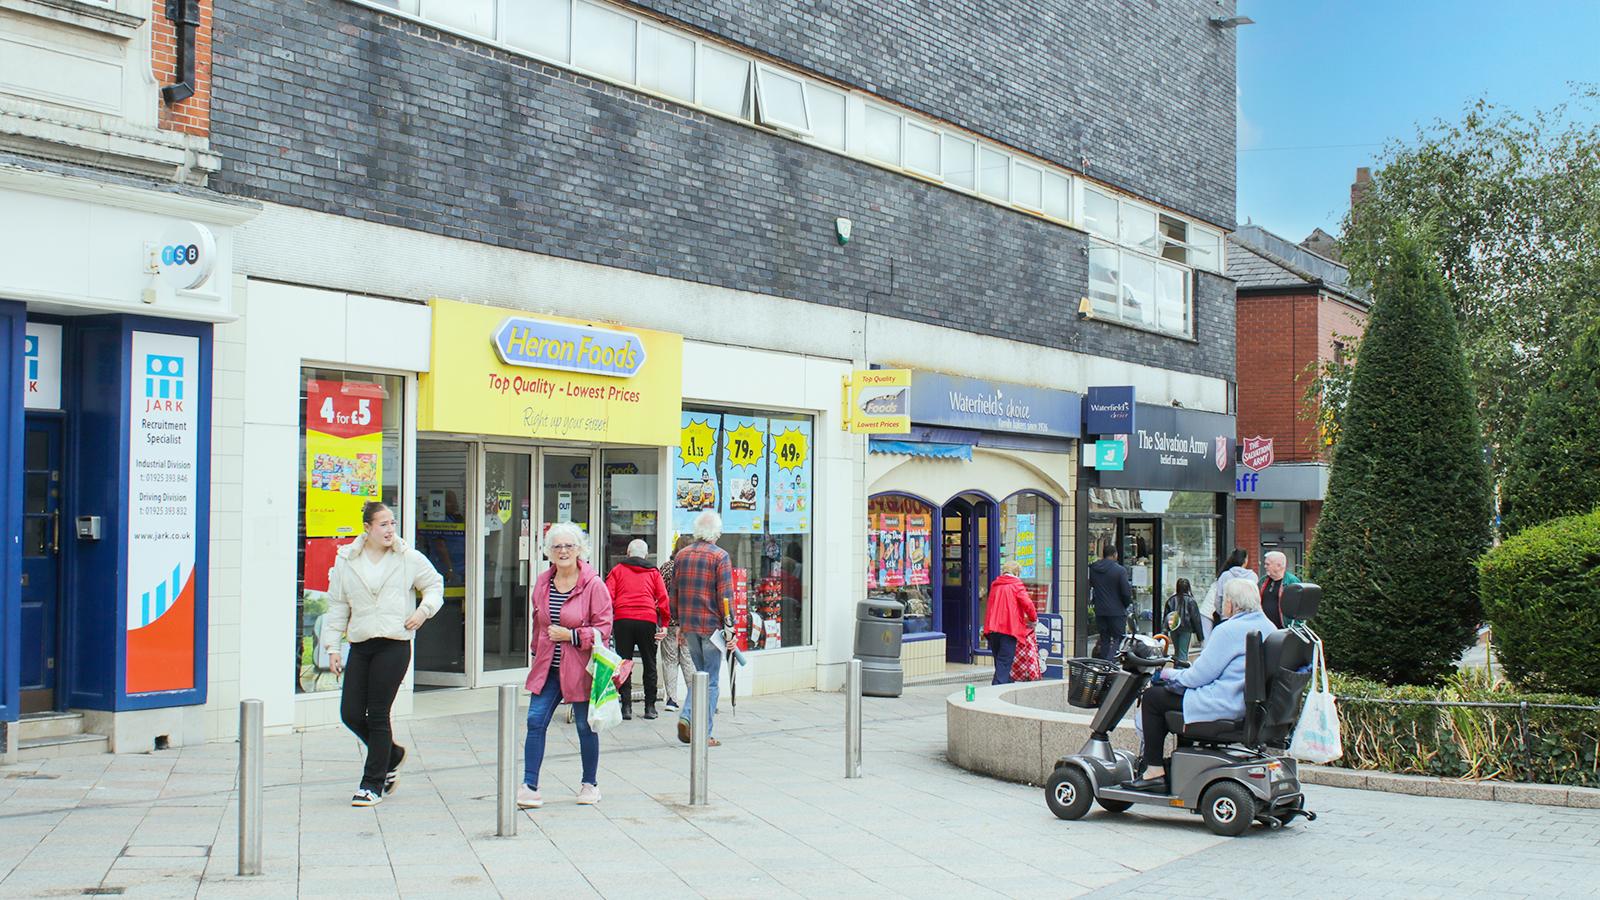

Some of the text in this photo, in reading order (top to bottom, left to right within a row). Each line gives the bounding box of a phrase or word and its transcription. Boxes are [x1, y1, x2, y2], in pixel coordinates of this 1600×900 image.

[163, 246, 197, 262] TSB
[507, 327, 638, 369] Heron Foods
[863, 375, 896, 384] Top Quality
[489, 373, 510, 394] Top
[513, 375, 555, 400] Quality
[566, 381, 605, 400] Lowest
[608, 386, 640, 403] Prices
[145, 399, 183, 413] JARK
[866, 402, 897, 413] Foods
[949, 389, 1031, 419] Waterfield's choice
[1090, 402, 1129, 412] Waterfield's
[320, 397, 371, 426] 4 for £5
[141, 418, 187, 431] Recruitment
[523, 406, 549, 434] Right
[550, 415, 561, 434] up
[564, 416, 584, 436] your
[146, 432, 182, 446] Specialist
[1138, 429, 1209, 459] The Salvation Army
[1249, 440, 1261, 450] THE
[734, 439, 754, 460] 79p
[780, 443, 801, 462] 49p
[1244, 444, 1271, 462] SALVATION
[136, 459, 191, 469] Industrial Division
[1252, 451, 1269, 467] ARMY
[139, 492, 187, 504] Driving Division
[432, 499, 441, 507] IN
[498, 498, 511, 511] OUT
[558, 502, 570, 510] OUT
[134, 531, 191, 541] www.jark.co.uk
